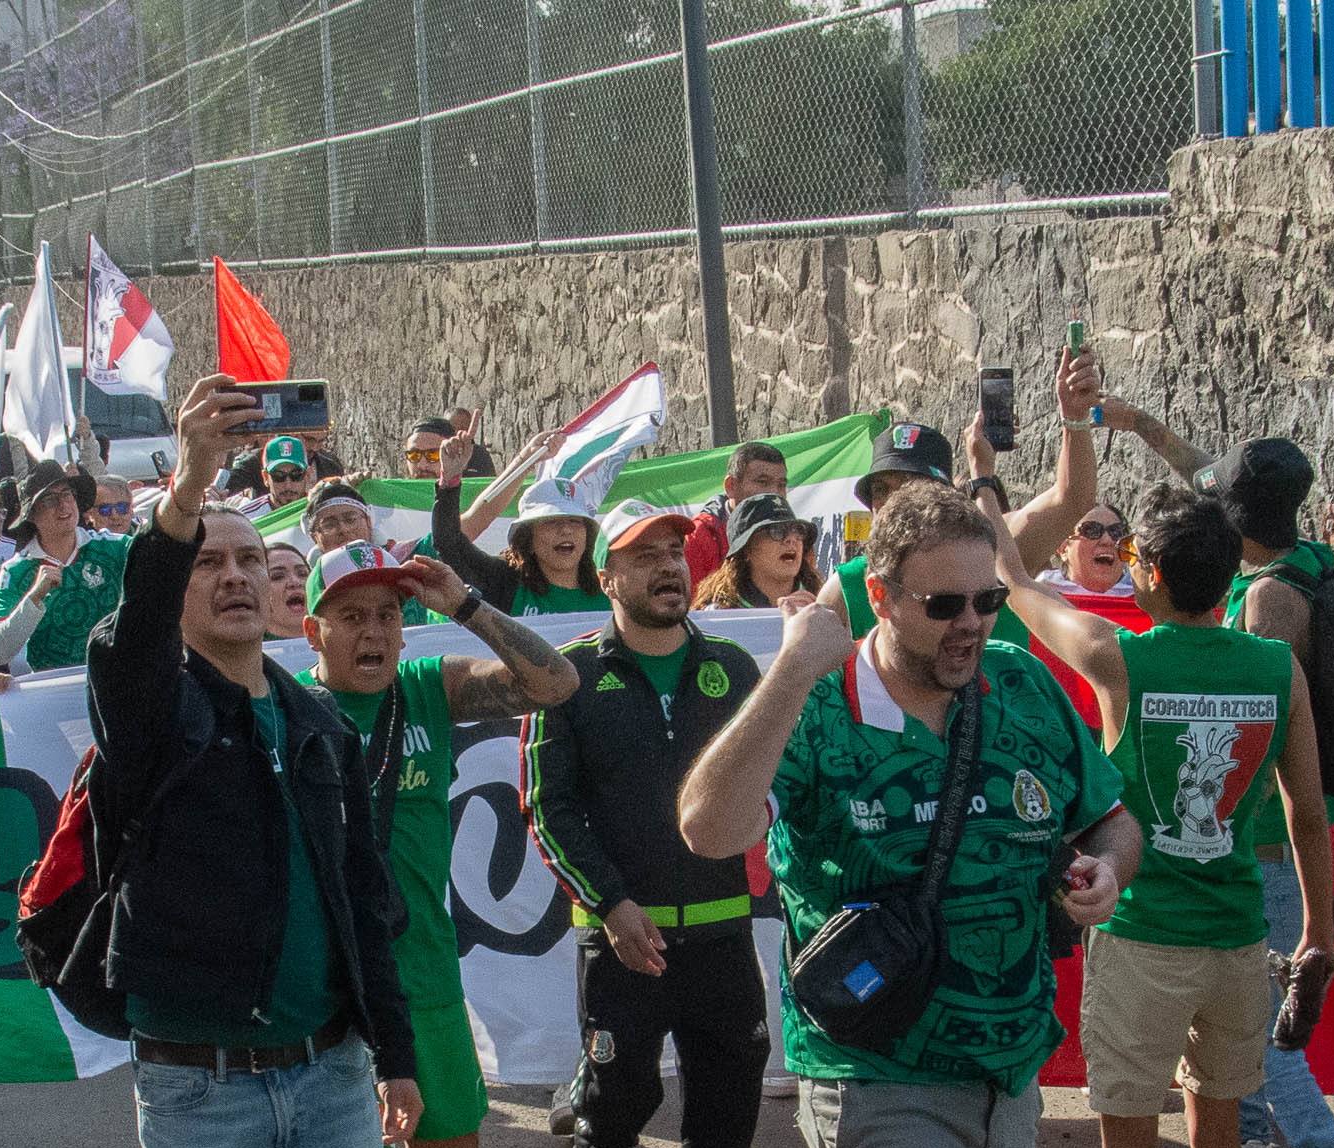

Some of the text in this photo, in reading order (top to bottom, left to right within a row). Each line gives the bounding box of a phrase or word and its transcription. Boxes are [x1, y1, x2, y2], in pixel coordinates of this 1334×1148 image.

[596, 682, 626, 692] adidas
[1144, 695, 1275, 718] CORAZÓN AZTECA
